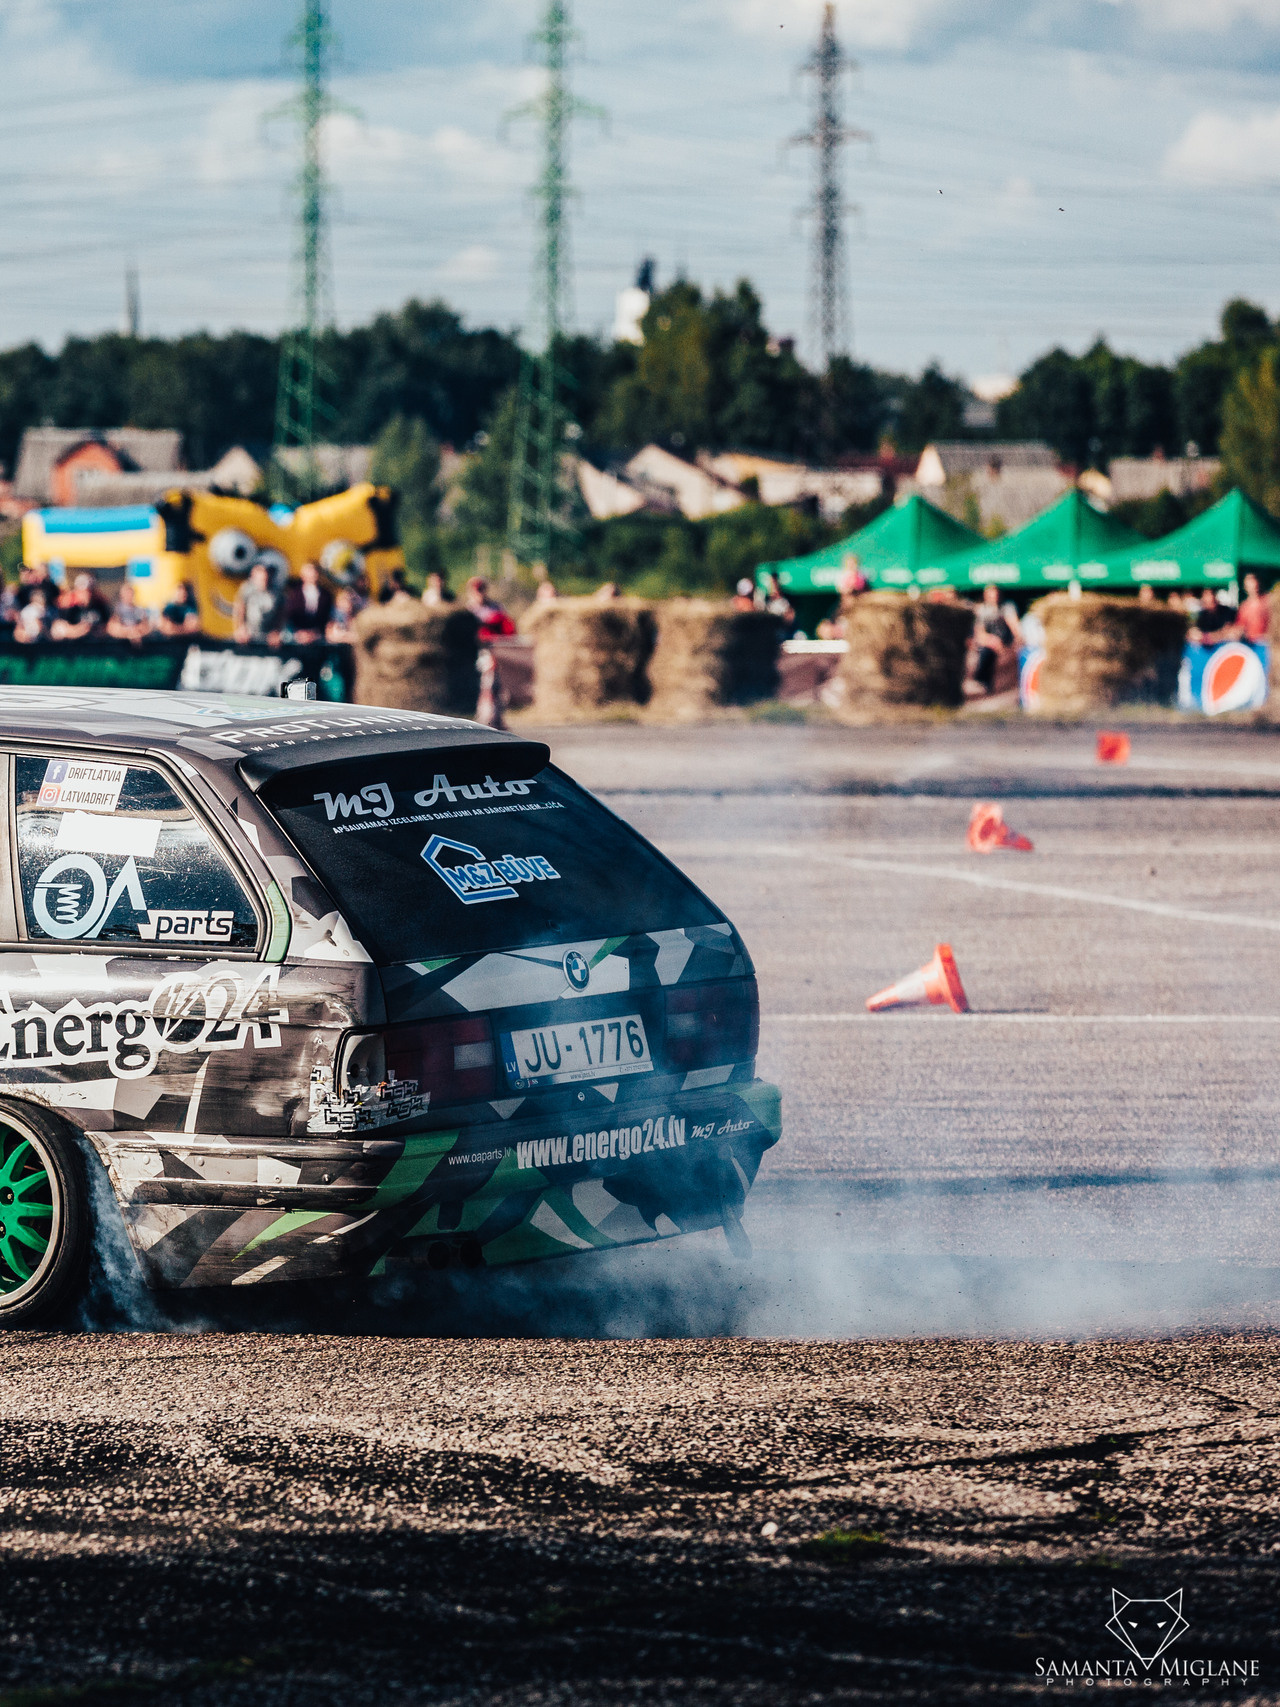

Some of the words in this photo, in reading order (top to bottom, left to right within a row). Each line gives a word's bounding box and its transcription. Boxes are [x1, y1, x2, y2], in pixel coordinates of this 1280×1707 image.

[68, 766, 121, 783] DRIFTLATVIA
[61, 790, 115, 806] LATVIADRIFT
[414, 774, 538, 807] Auto
[388, 813, 434, 826] IZCELSMES
[472, 808, 484, 816] AR
[446, 863, 502, 891] M&Z
[496, 855, 561, 885] BŪVE
[157, 910, 231, 936] parts
[524, 1020, 644, 1073] JU-1776
[505, 1061, 517, 1073] LV
[717, 1119, 755, 1136] Auto
[516, 1114, 686, 1170] www.energo24.lv
[448, 1147, 511, 1165] www.oaparts.lv
